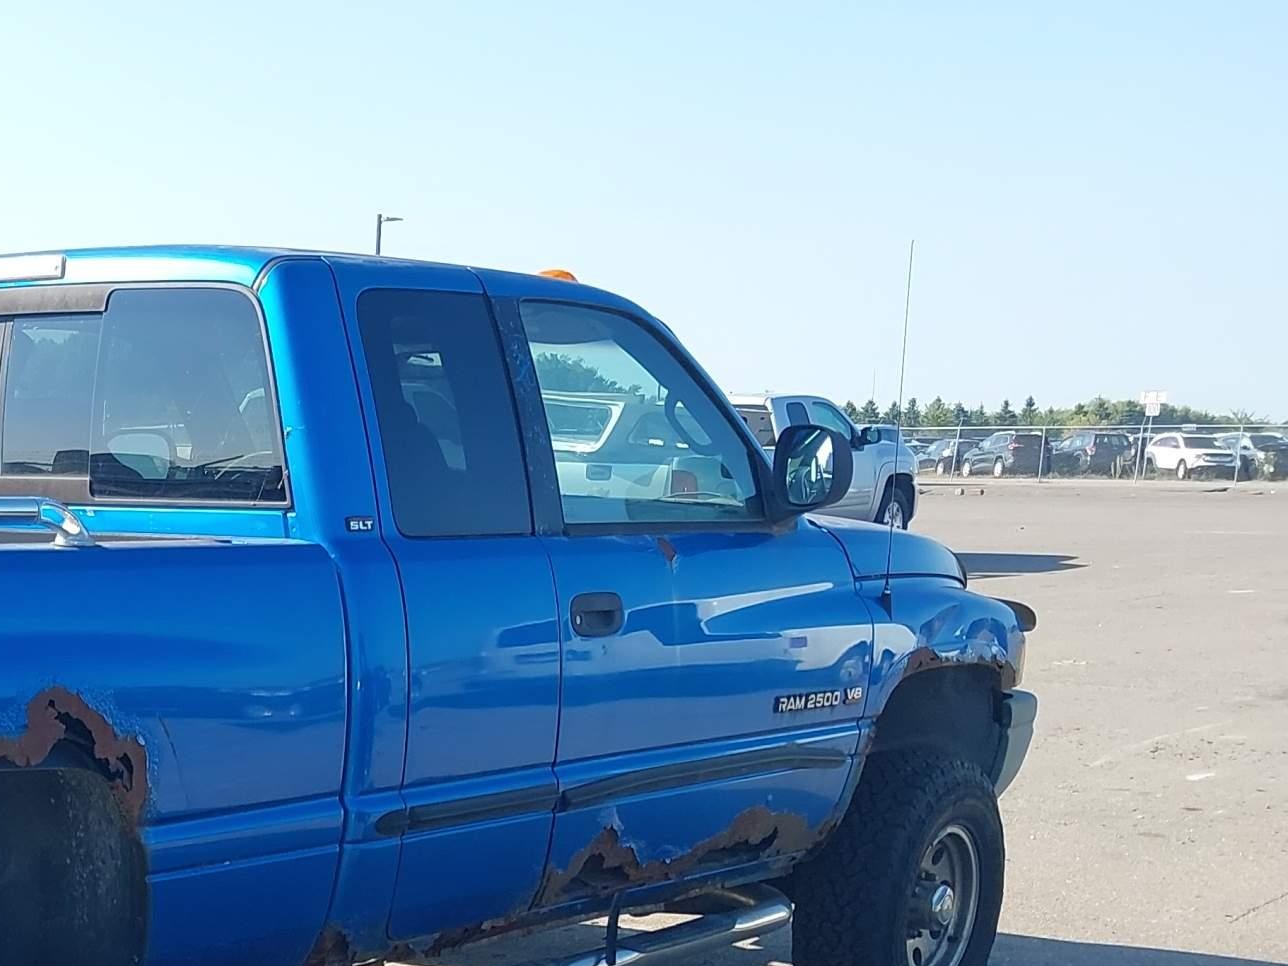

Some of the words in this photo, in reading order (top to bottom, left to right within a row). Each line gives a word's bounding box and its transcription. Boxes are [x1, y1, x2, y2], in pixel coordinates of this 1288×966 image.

[350, 520, 373, 530] SLT
[778, 696, 805, 712] RAM
[807, 691, 840, 709] 2500
[846, 687, 862, 700] V8
